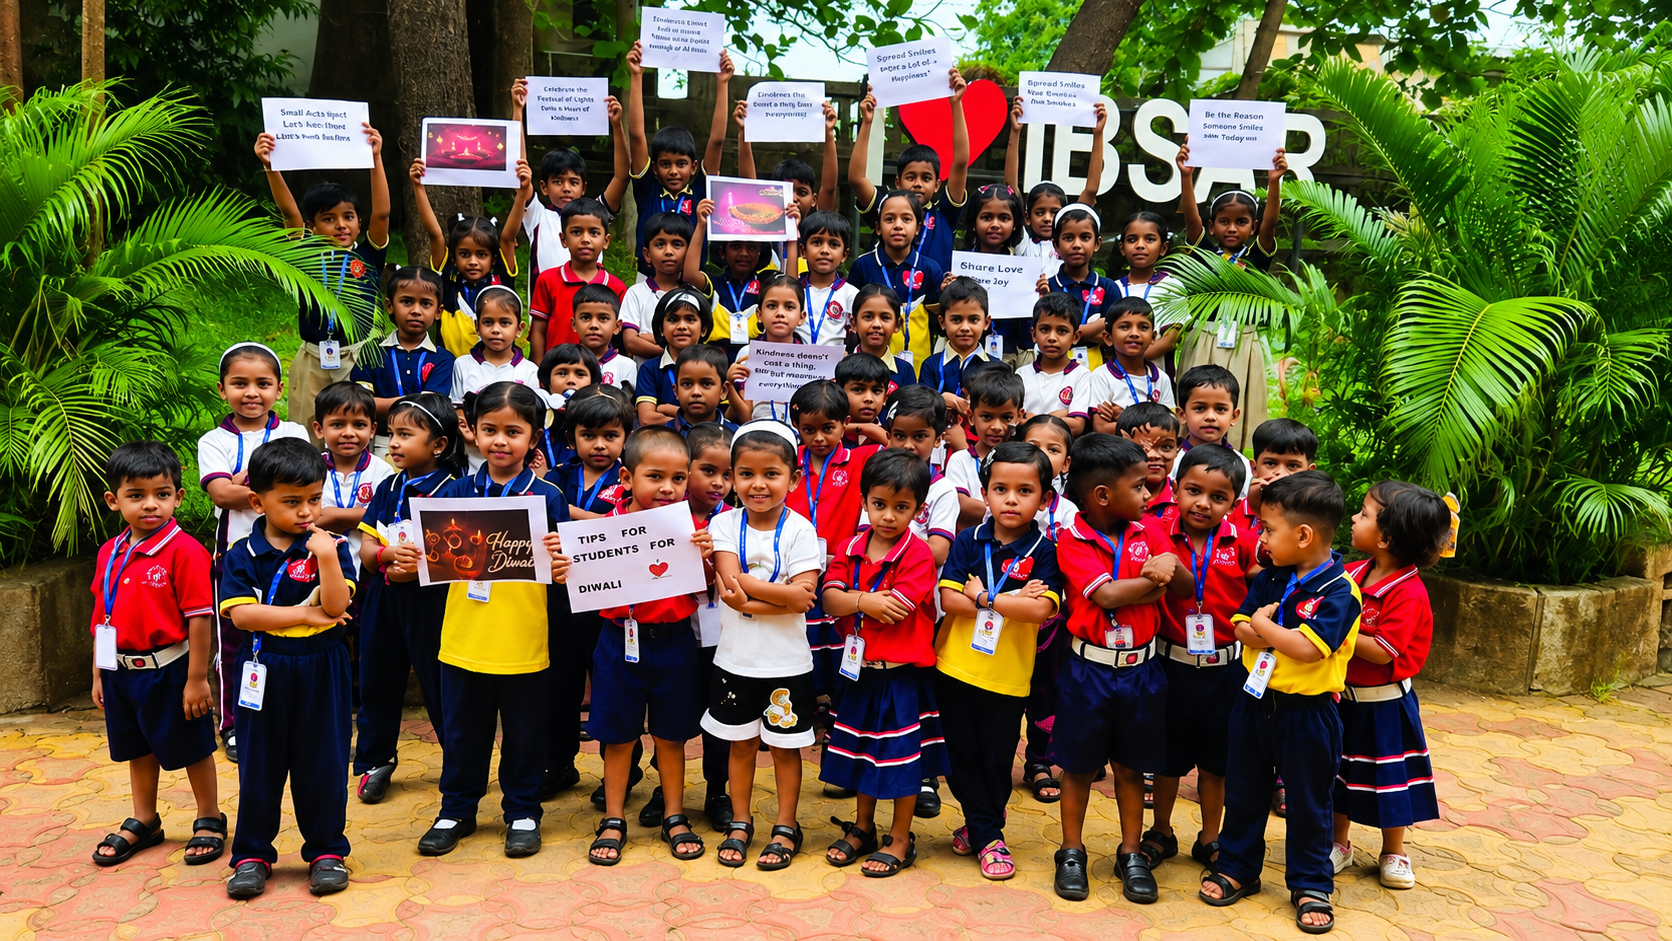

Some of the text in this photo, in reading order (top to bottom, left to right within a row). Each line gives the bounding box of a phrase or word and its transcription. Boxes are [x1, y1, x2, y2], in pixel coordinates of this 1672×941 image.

[1217, 111, 1232, 119] the
[1233, 112, 1264, 120] Reason
[1203, 122, 1264, 131] Someone Smiles
[1221, 134, 1245, 143] Today
[960, 261, 1024, 274] Share Love
[993, 277, 1010, 288] Joy
[578, 525, 647, 545] TIPS FOR
[485, 529, 533, 556] Happy
[573, 537, 675, 564] STUDENTS FOR
[578, 579, 622, 594] DIWALI
